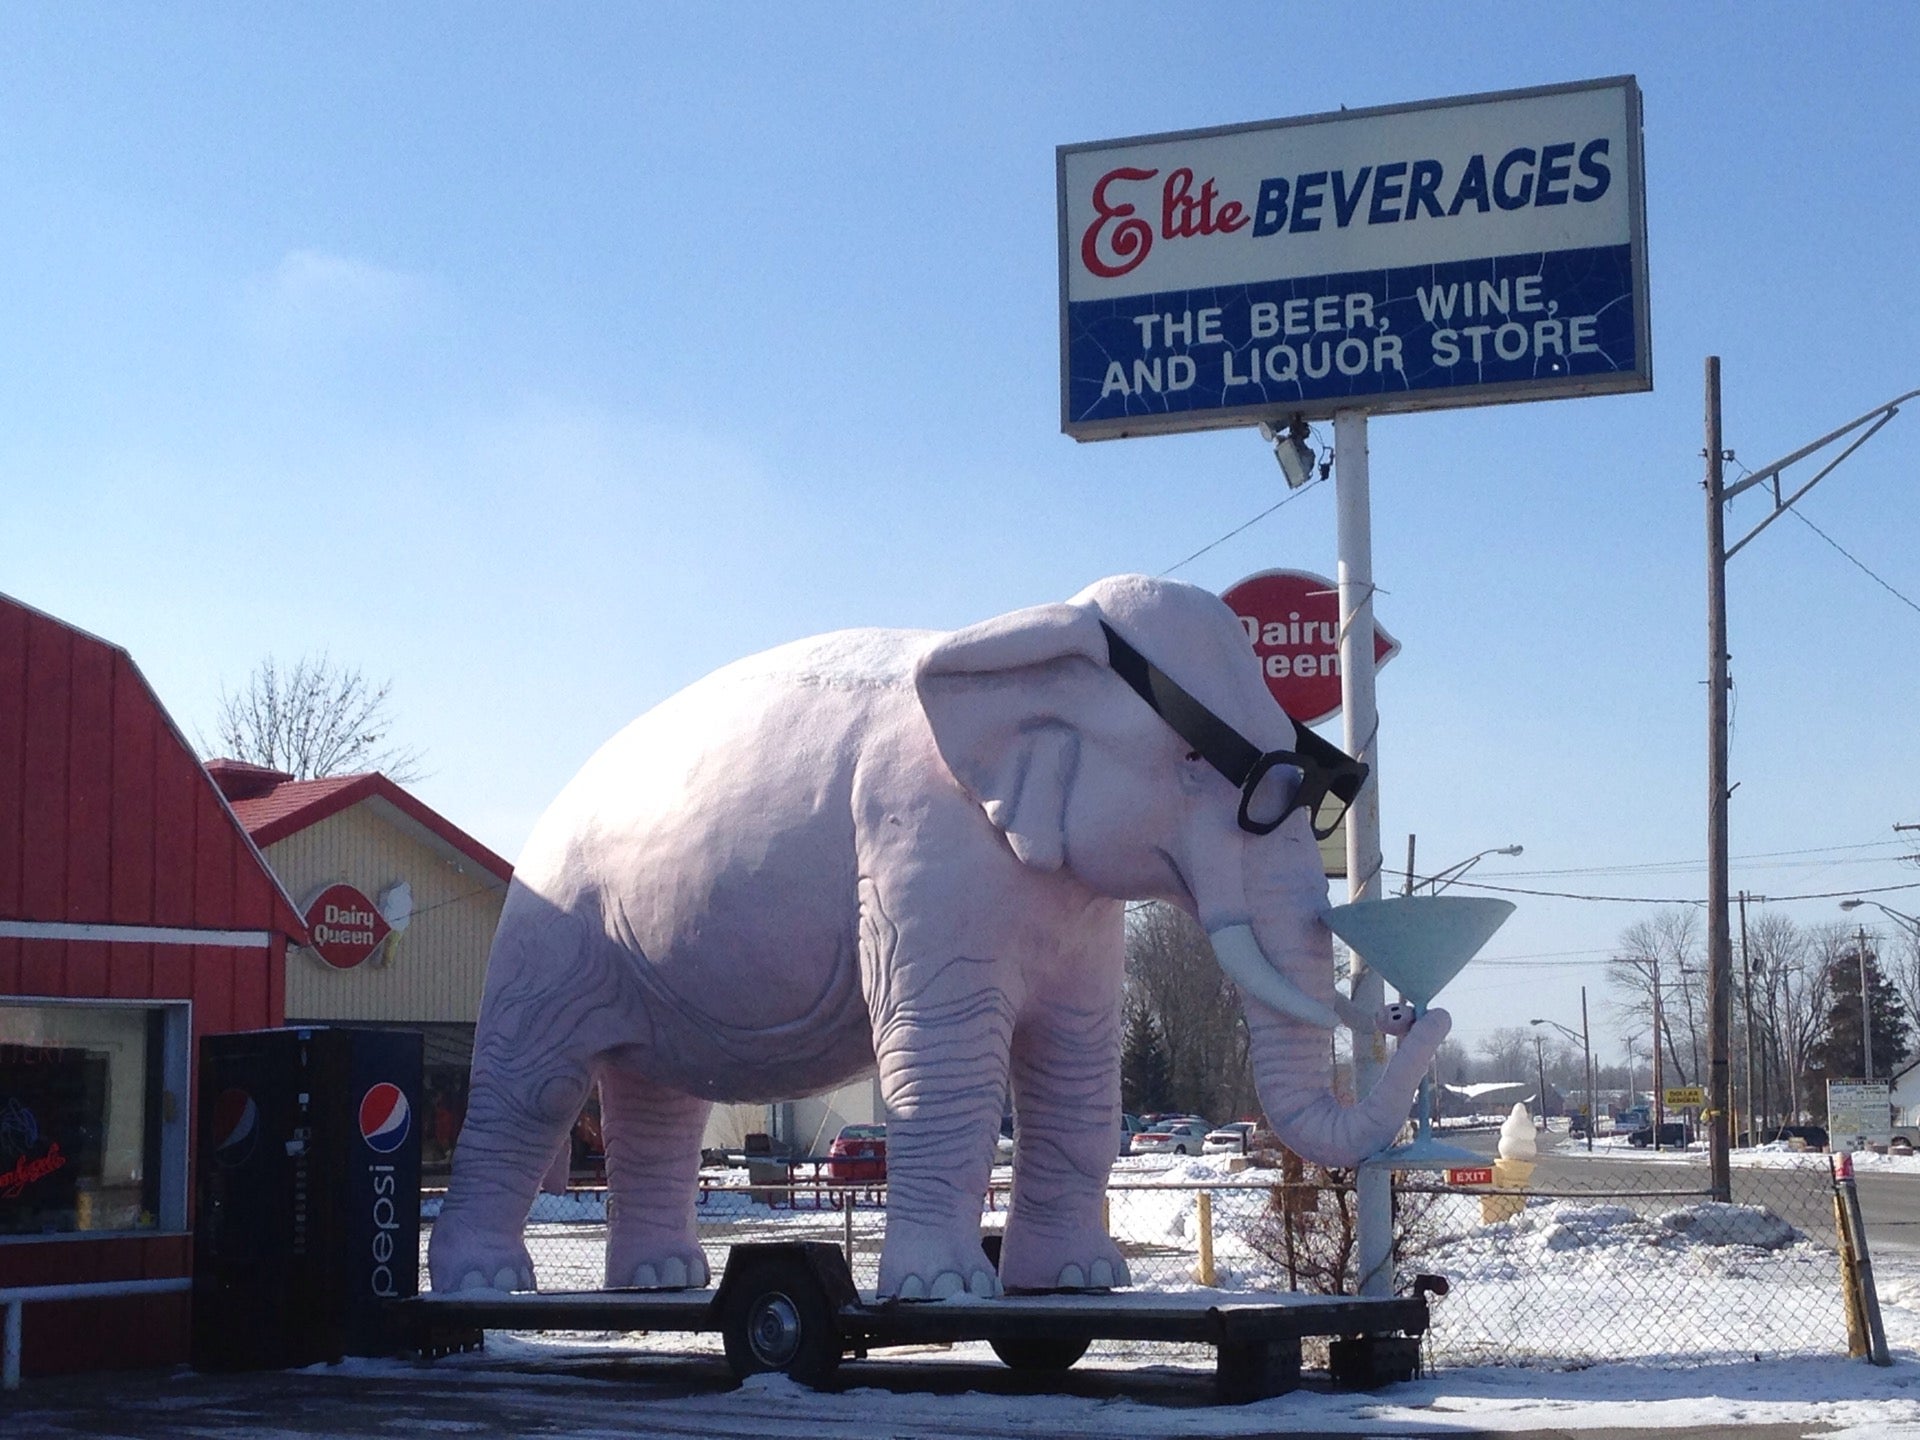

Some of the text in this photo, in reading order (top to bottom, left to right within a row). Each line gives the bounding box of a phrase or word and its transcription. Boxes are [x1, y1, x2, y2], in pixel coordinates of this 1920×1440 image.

[1081, 138, 1611, 278] Elite BEVERAGES
[1134, 275, 1559, 350] THE BEER, WINE,
[1102, 315, 1598, 398] AND LIQUOR STORE
[1256, 652, 1342, 678] een
[314, 924, 374, 946] Queen
[325, 904, 374, 929] Dairy
[1456, 1171, 1486, 1182] EXIT
[368, 1164, 400, 1298] pepsi
